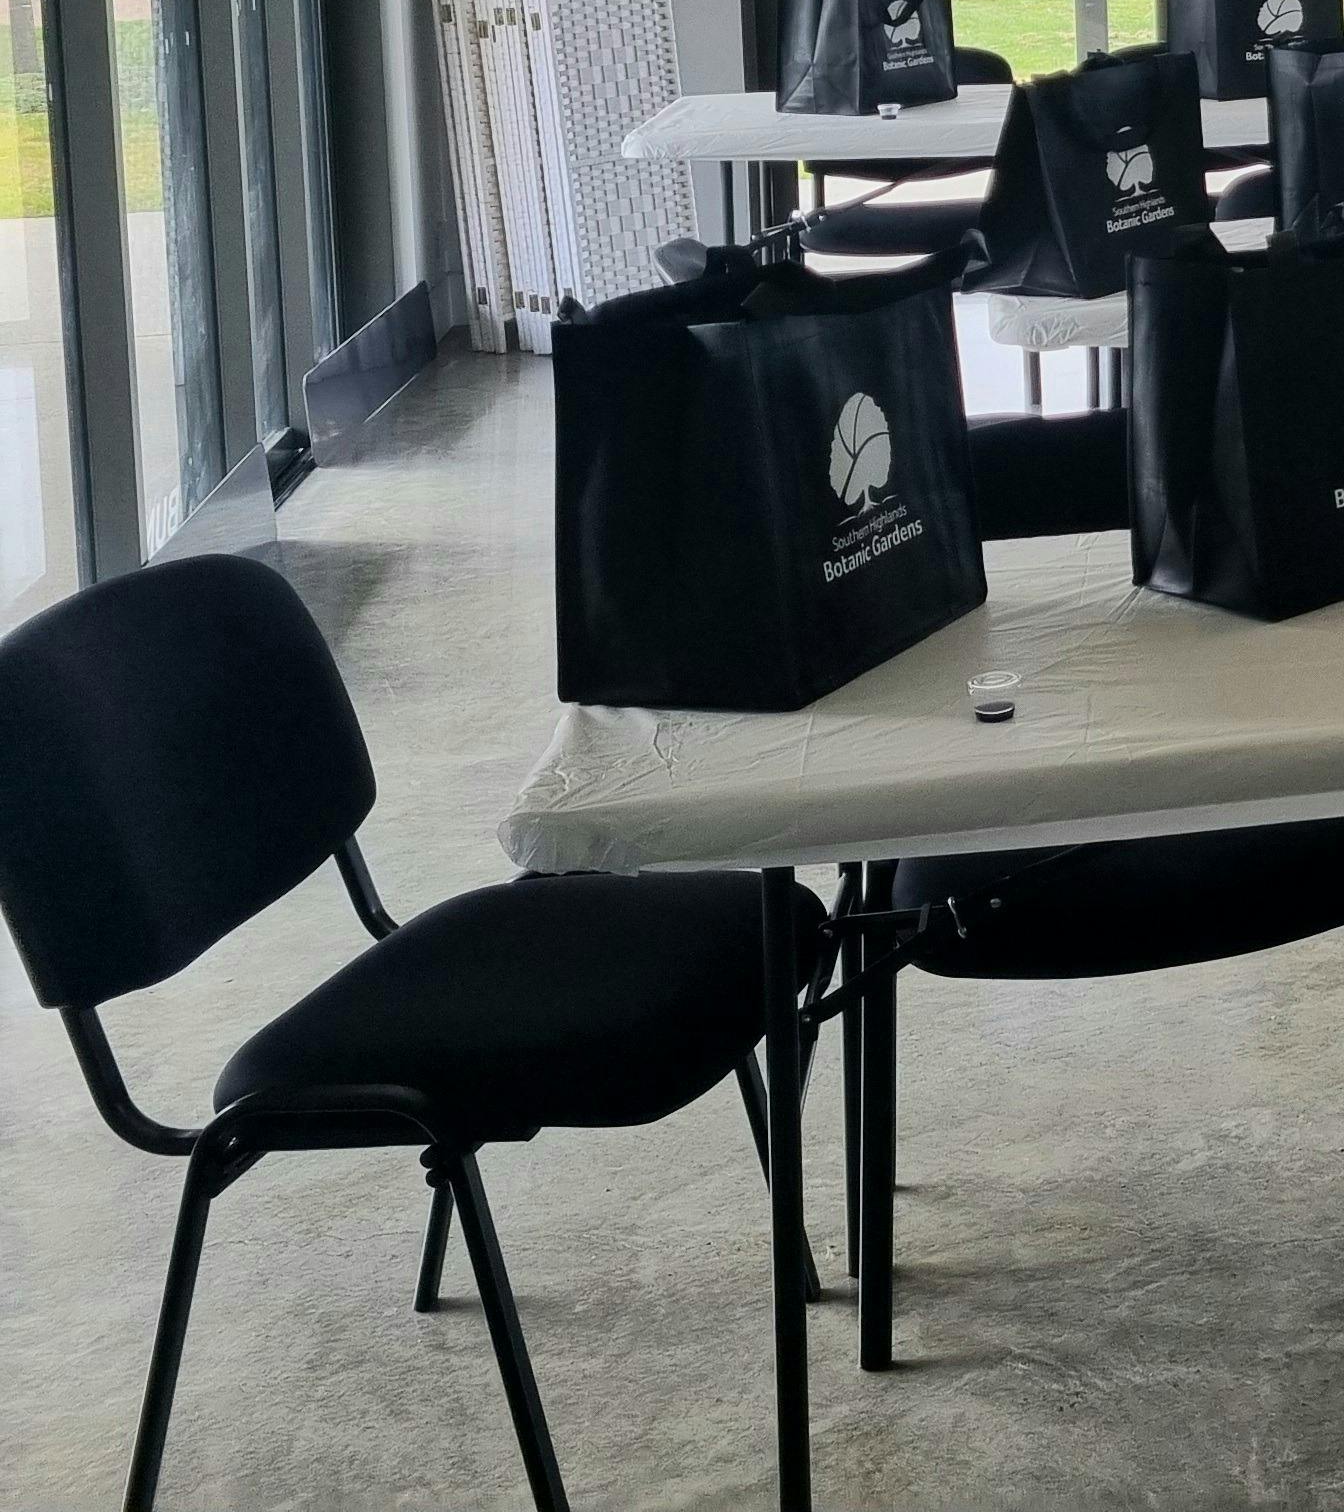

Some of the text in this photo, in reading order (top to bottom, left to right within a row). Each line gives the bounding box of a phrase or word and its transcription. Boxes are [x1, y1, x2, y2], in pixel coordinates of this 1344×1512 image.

[1106, 206, 1175, 233] Botanic Gardens
[823, 519, 923, 583] Botanic Gardens
[832, 525, 869, 552] Southern
